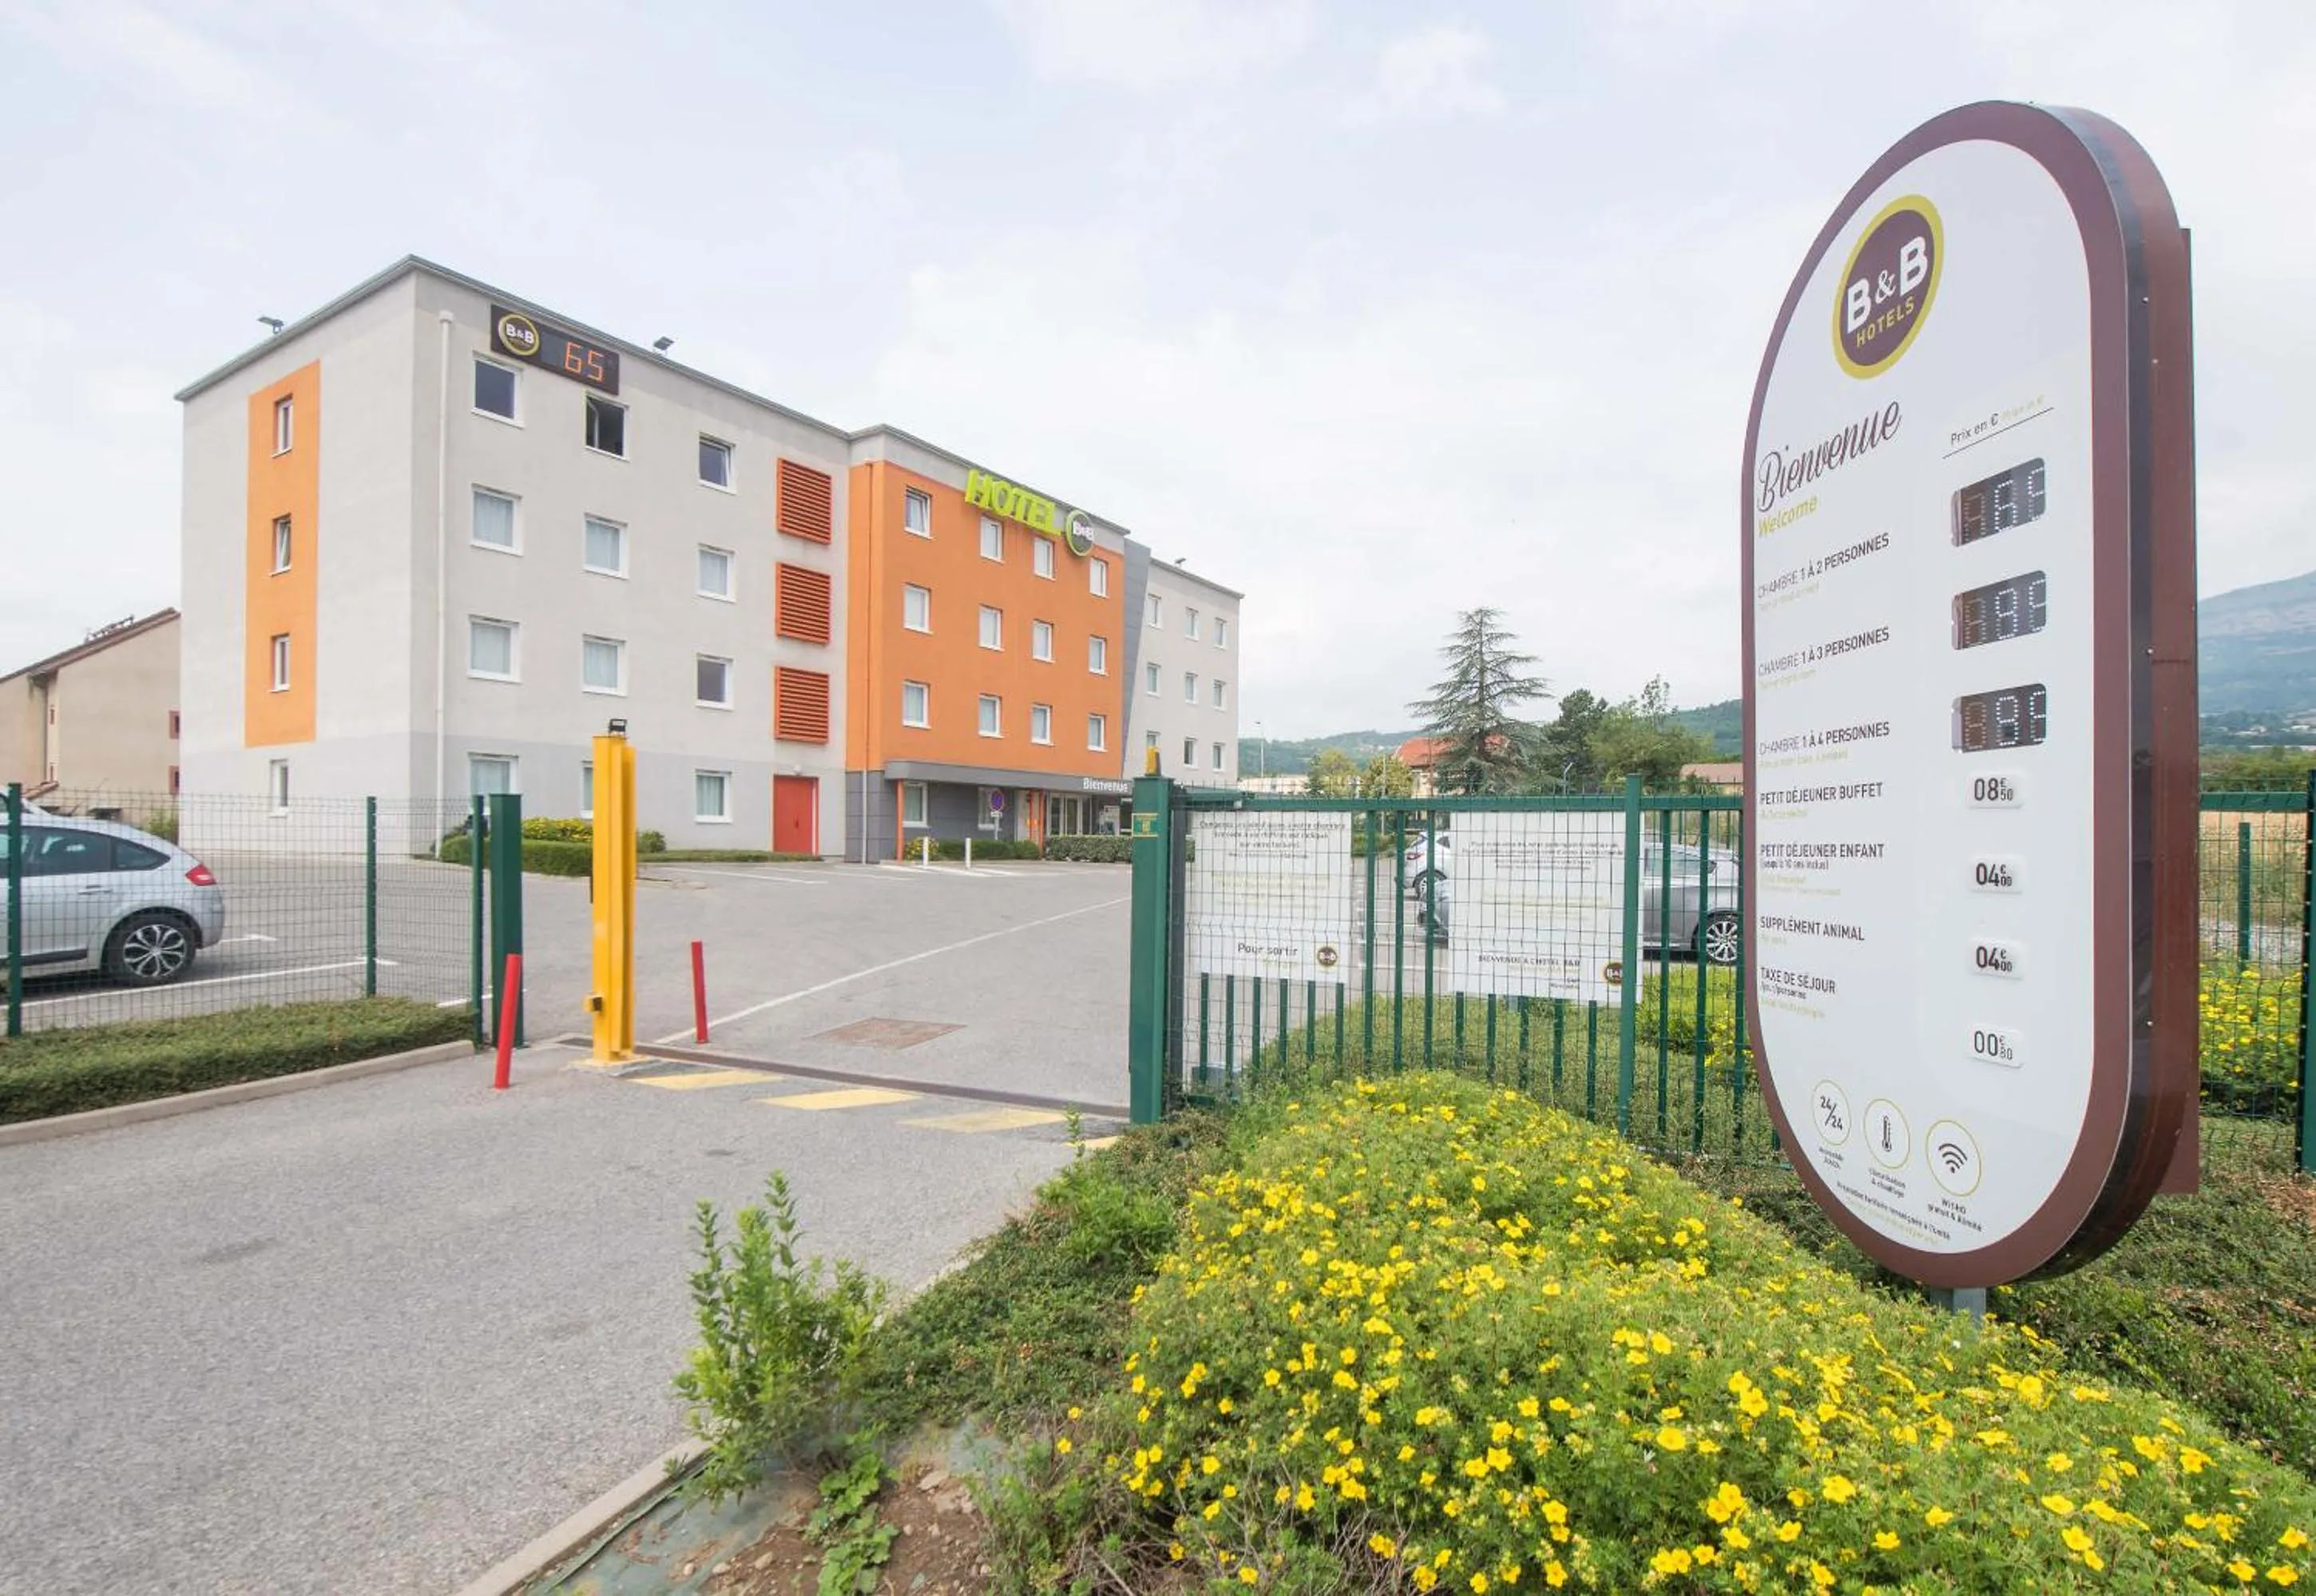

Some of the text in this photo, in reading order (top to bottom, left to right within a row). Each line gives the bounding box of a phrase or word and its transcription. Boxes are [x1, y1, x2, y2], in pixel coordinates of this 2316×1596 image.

[1847, 236, 1928, 334] B&B
[506, 323, 534, 344] B&B
[1857, 296, 1915, 348] HOTELS
[564, 341, 605, 382] 65
[1951, 429, 1971, 445] Prix
[1974, 422, 1988, 434] en
[1757, 401, 1902, 513] Bienvenue
[965, 469, 1061, 537] HOTEL
[1759, 496, 1818, 537] Welcome
[1758, 570, 1798, 599] CHAMBRE
[1816, 560, 1822, 574] 2
[1824, 532, 1890, 572] PERSONNES
[1759, 653, 1799, 676] CHAMBRE
[1817, 647, 1823, 660] 3
[1825, 626, 1890, 657] PERSONNES
[1759, 735, 1799, 755] CHAMBRE
[1818, 733, 1824, 745] 4
[1826, 722, 1890, 745] PERSONNES
[1083, 778, 1128, 793] Bienvenue
[1760, 782, 1883, 805] PETIT DÉJEUNER BUFFET
[1760, 844, 1784, 857] PETIT
[1840, 843, 1885, 857] ENFANT
[1760, 915, 1866, 941] SUPPLÉMENT ANIMAL
[1238, 943, 1263, 953] Pour
[1761, 967, 1782, 983] TAXE
[1783, 971, 1795, 985] DE
